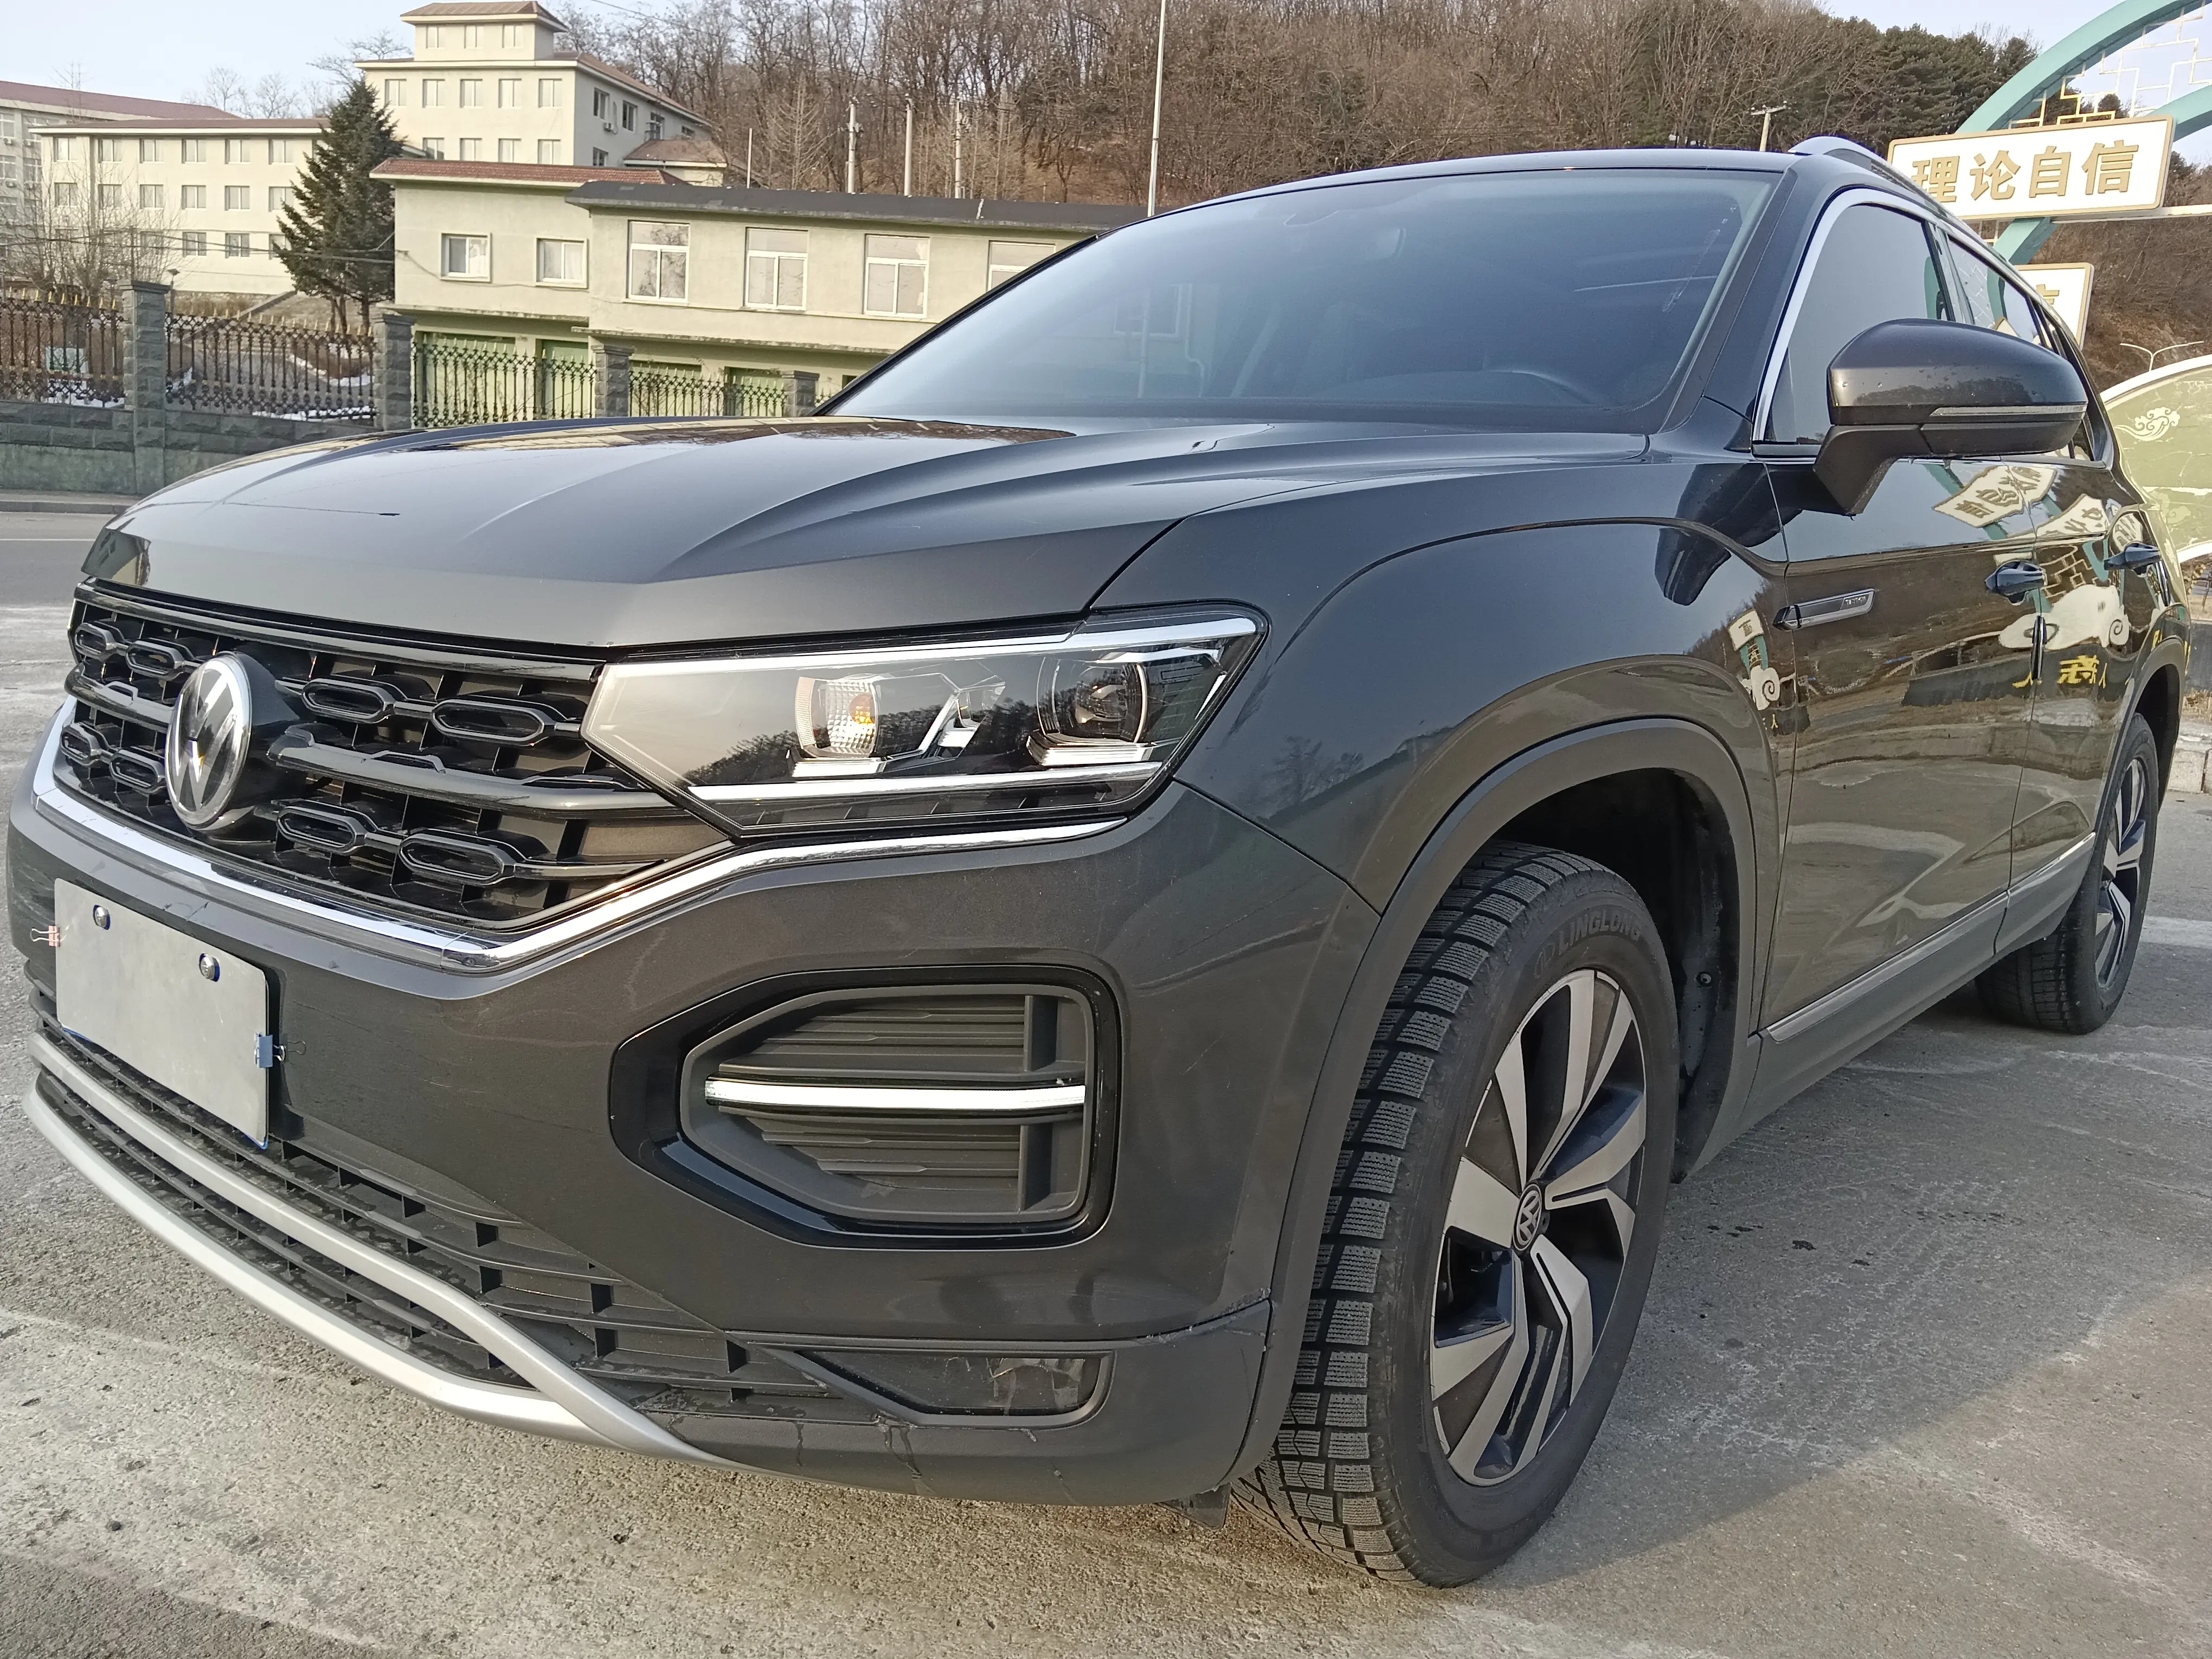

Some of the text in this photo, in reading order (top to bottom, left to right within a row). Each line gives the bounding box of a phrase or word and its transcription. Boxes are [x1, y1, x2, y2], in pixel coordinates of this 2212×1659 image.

[1911, 139, 2139, 203] 理论自信
[1558, 909, 1642, 956] LINGLONG
